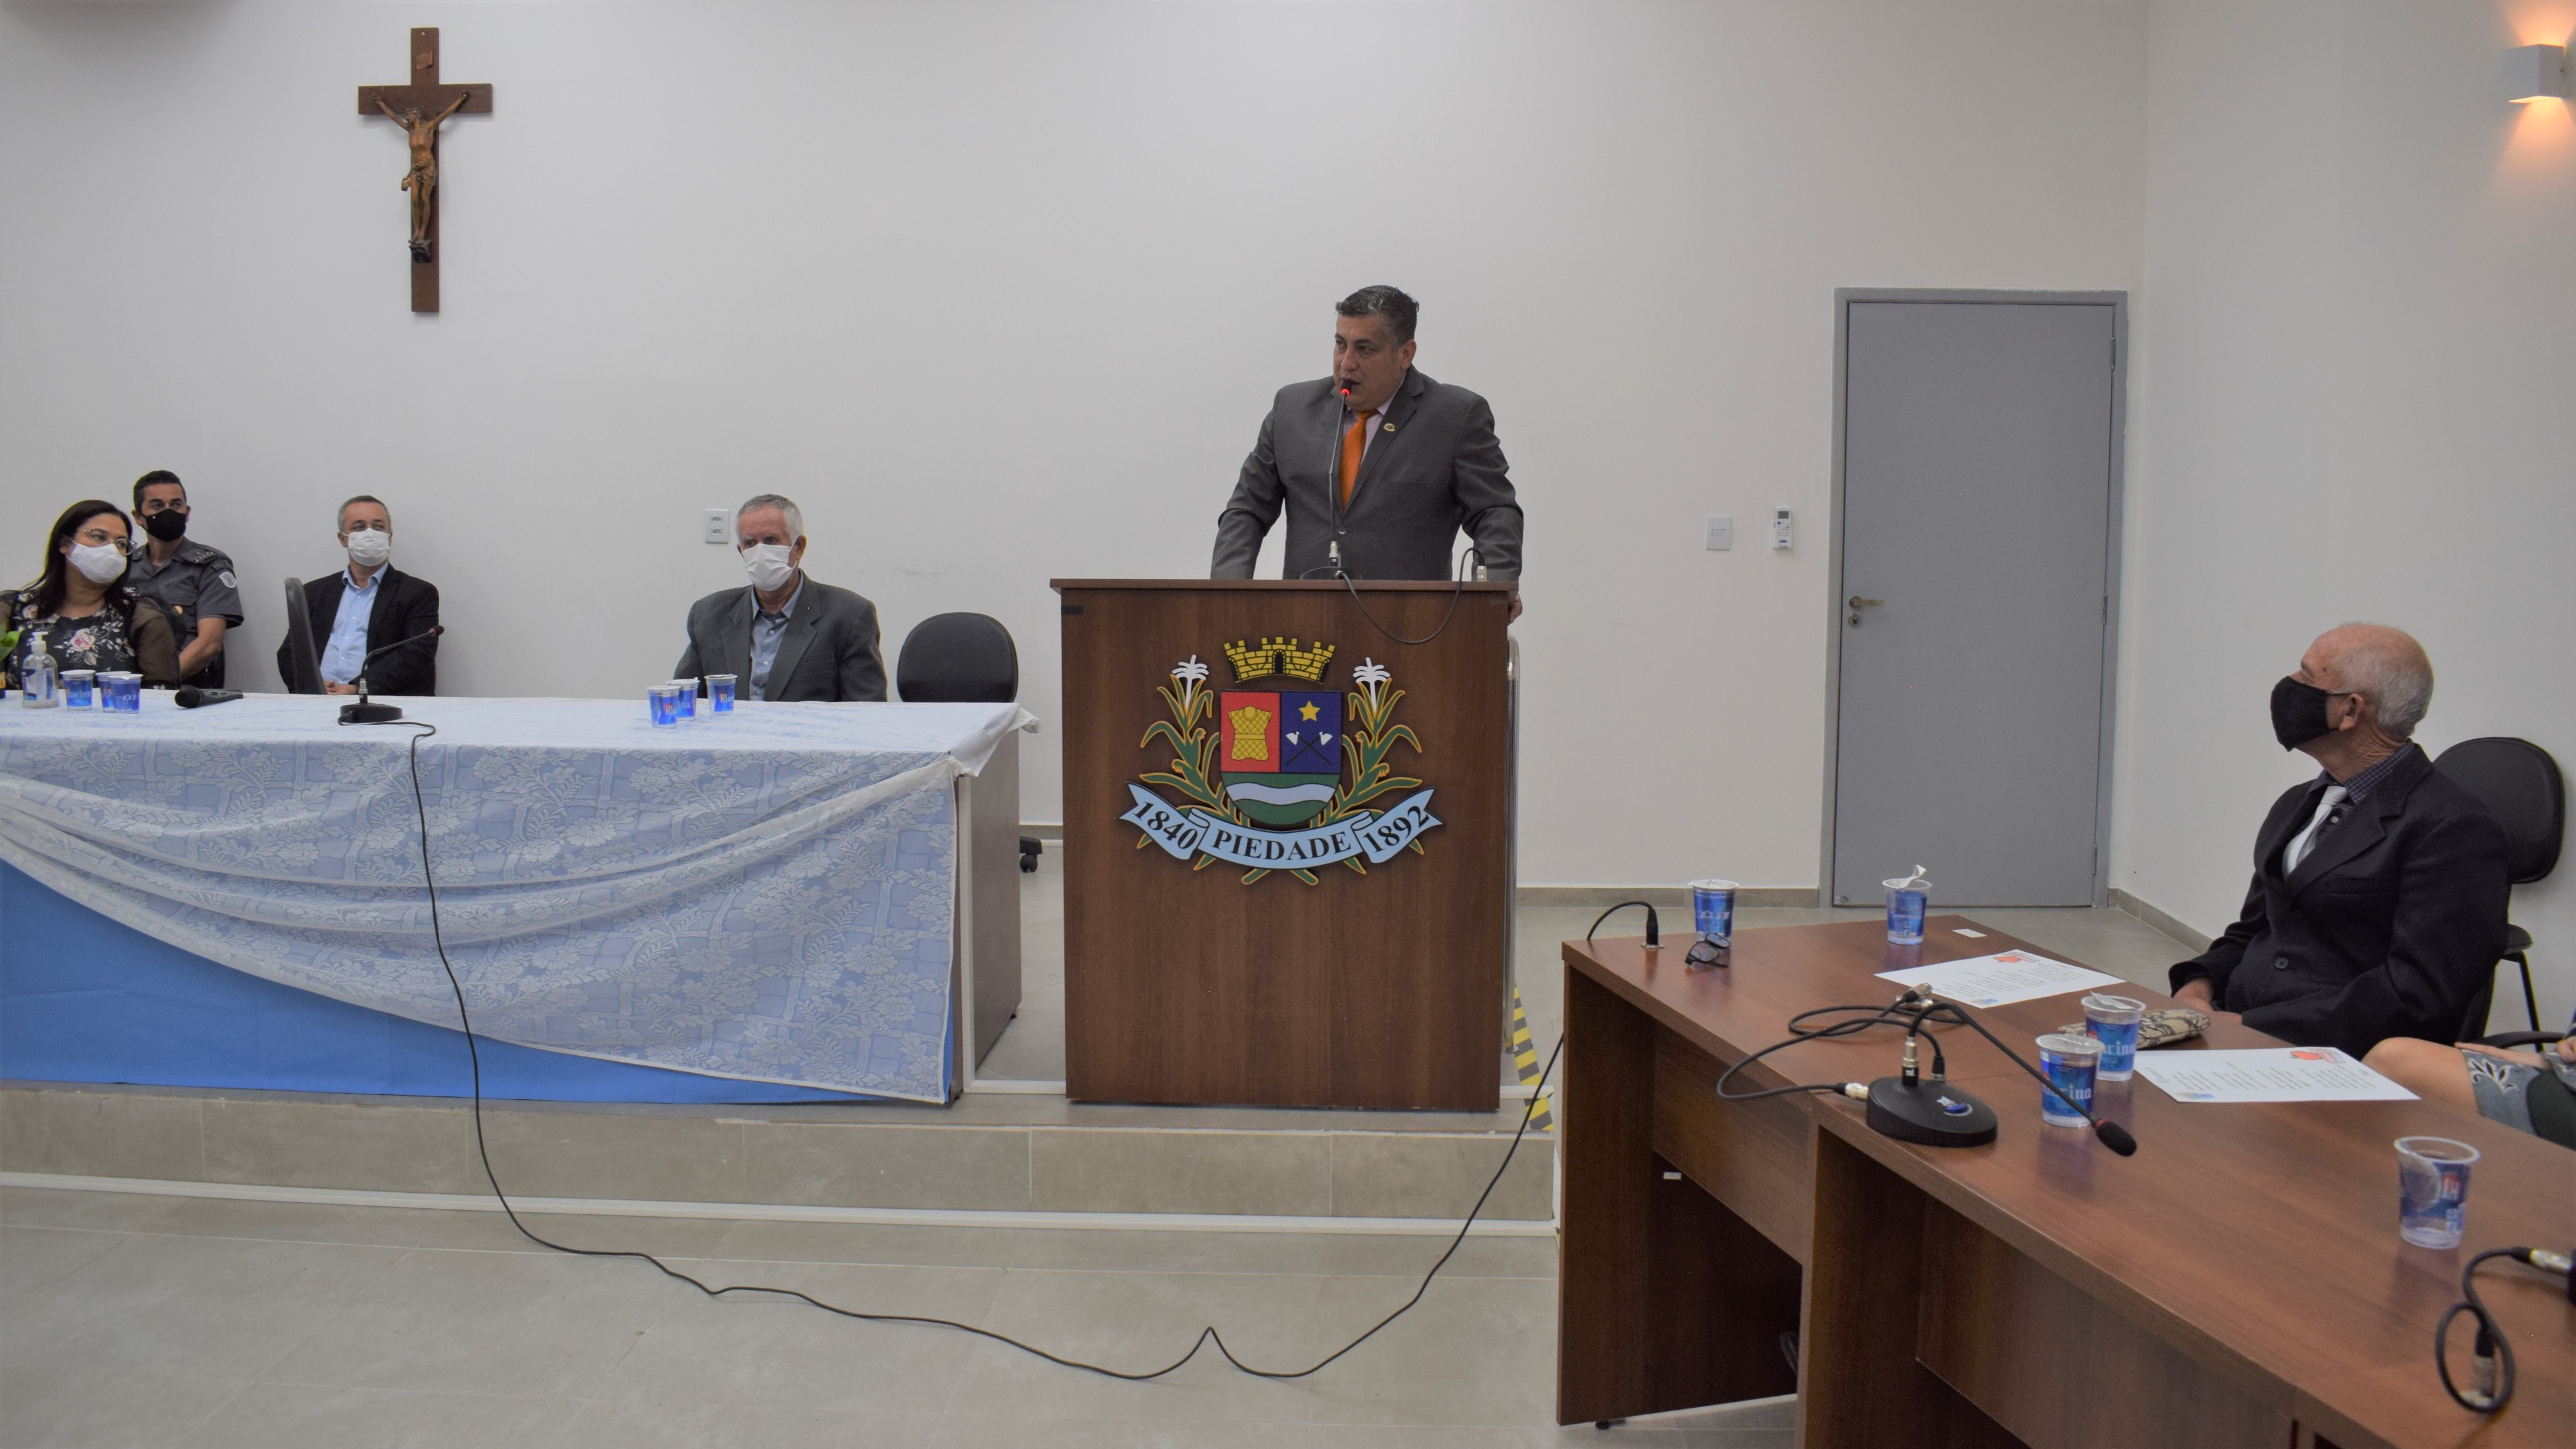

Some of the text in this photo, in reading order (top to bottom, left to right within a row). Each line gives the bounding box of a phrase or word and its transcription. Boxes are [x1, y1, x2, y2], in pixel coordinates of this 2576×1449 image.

[1133, 802, 1430, 861] 1840 PIEDADE 1892
